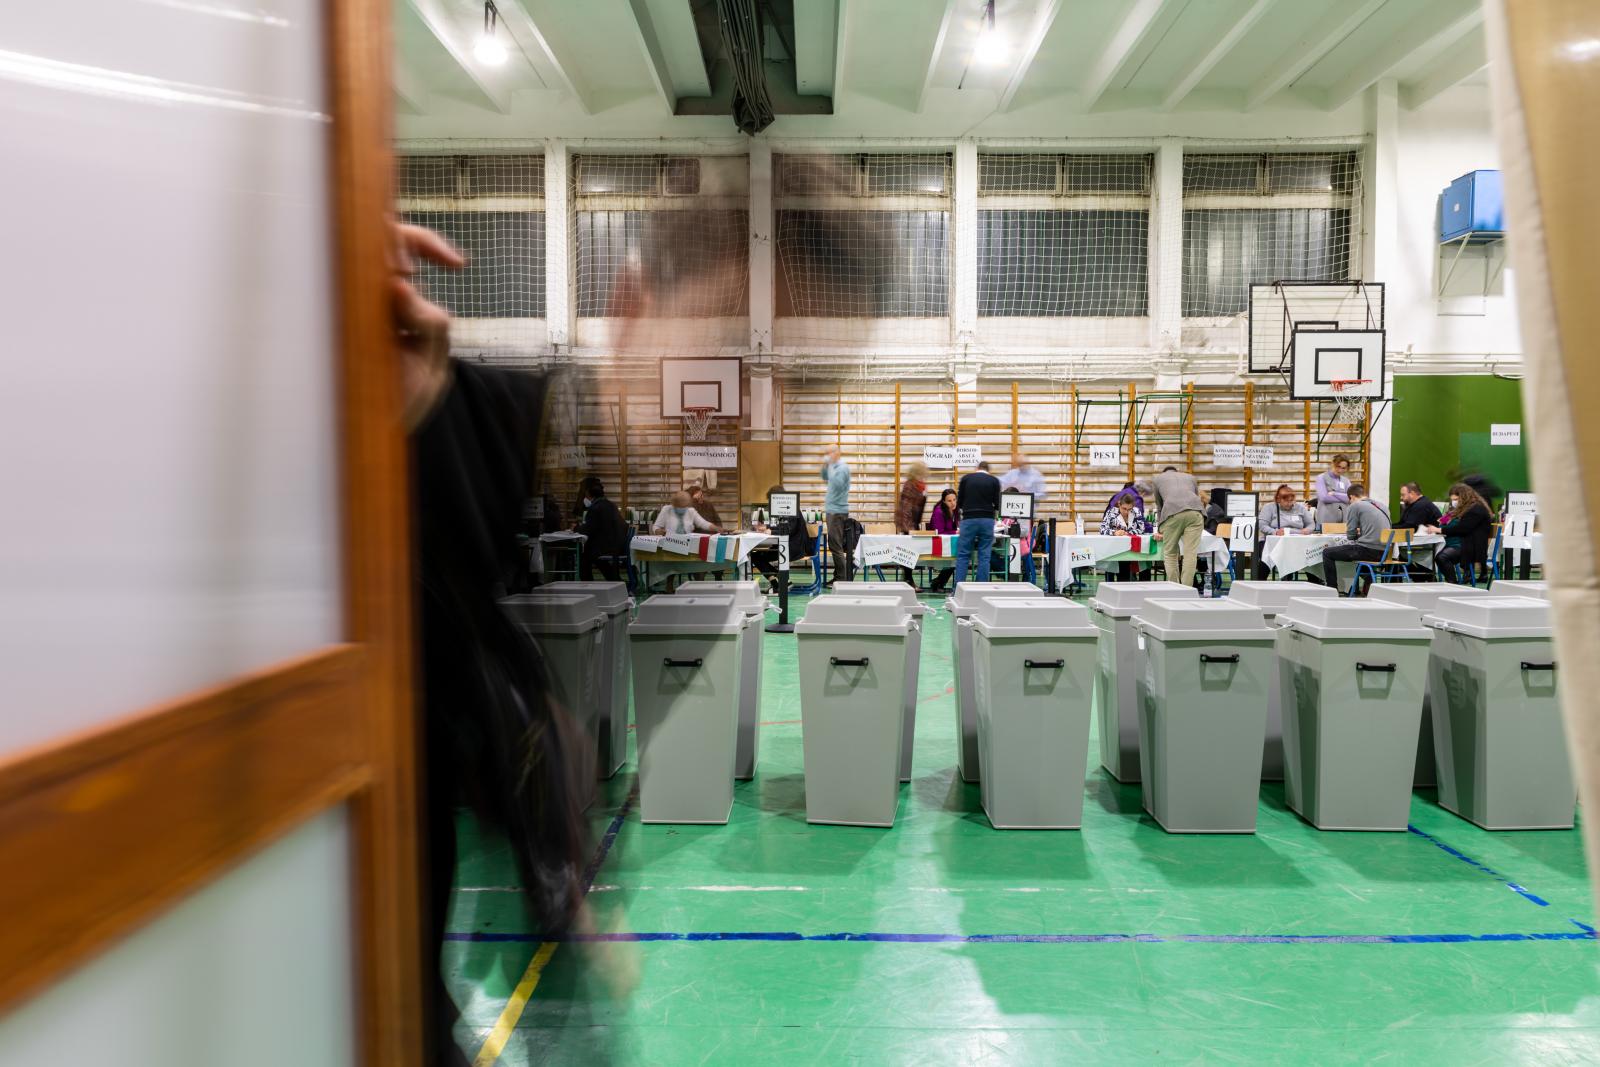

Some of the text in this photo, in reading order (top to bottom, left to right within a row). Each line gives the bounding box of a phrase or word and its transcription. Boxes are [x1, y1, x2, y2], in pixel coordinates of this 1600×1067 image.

[1093, 451, 1115, 459] PEST
[1006, 501, 1025, 510] PEST
[1234, 523, 1254, 541] 10
[1509, 520, 1529, 538] 11
[1071, 553, 1092, 562] PEST
